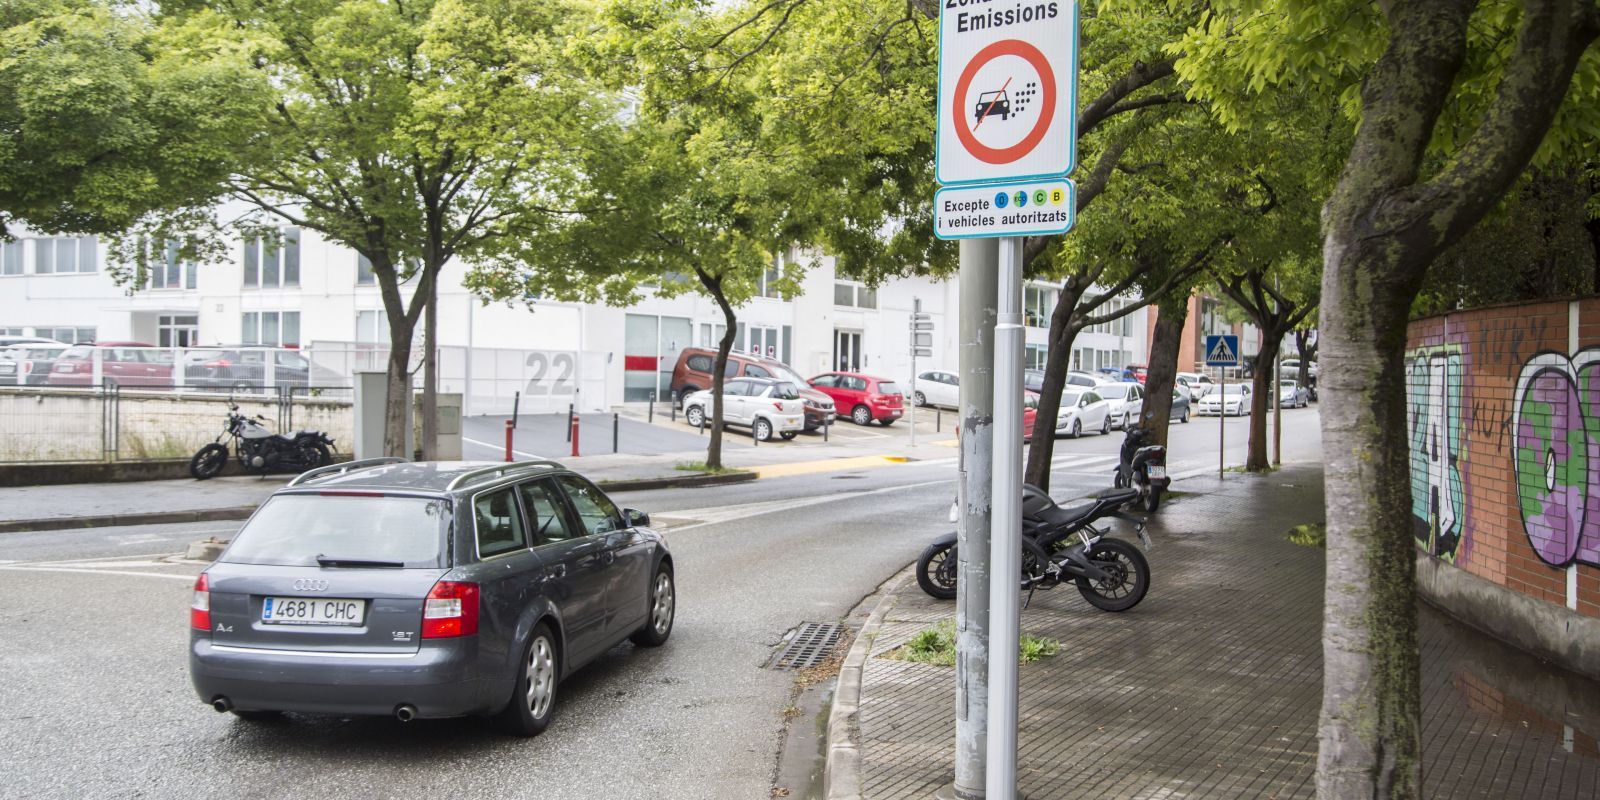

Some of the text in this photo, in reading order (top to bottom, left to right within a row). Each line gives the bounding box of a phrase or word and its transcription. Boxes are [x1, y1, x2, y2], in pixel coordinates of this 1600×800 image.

[957, 2, 1058, 33] Emissions
[944, 199, 990, 213] Excepte
[1036, 193, 1045, 203] C
[1053, 192, 1061, 202] B
[948, 215, 995, 228] vehicles
[1001, 210, 1067, 225] autoritzats
[525, 352, 573, 396] 22
[275, 600, 357, 620] 4681 CHC
[215, 622, 233, 633] A4
